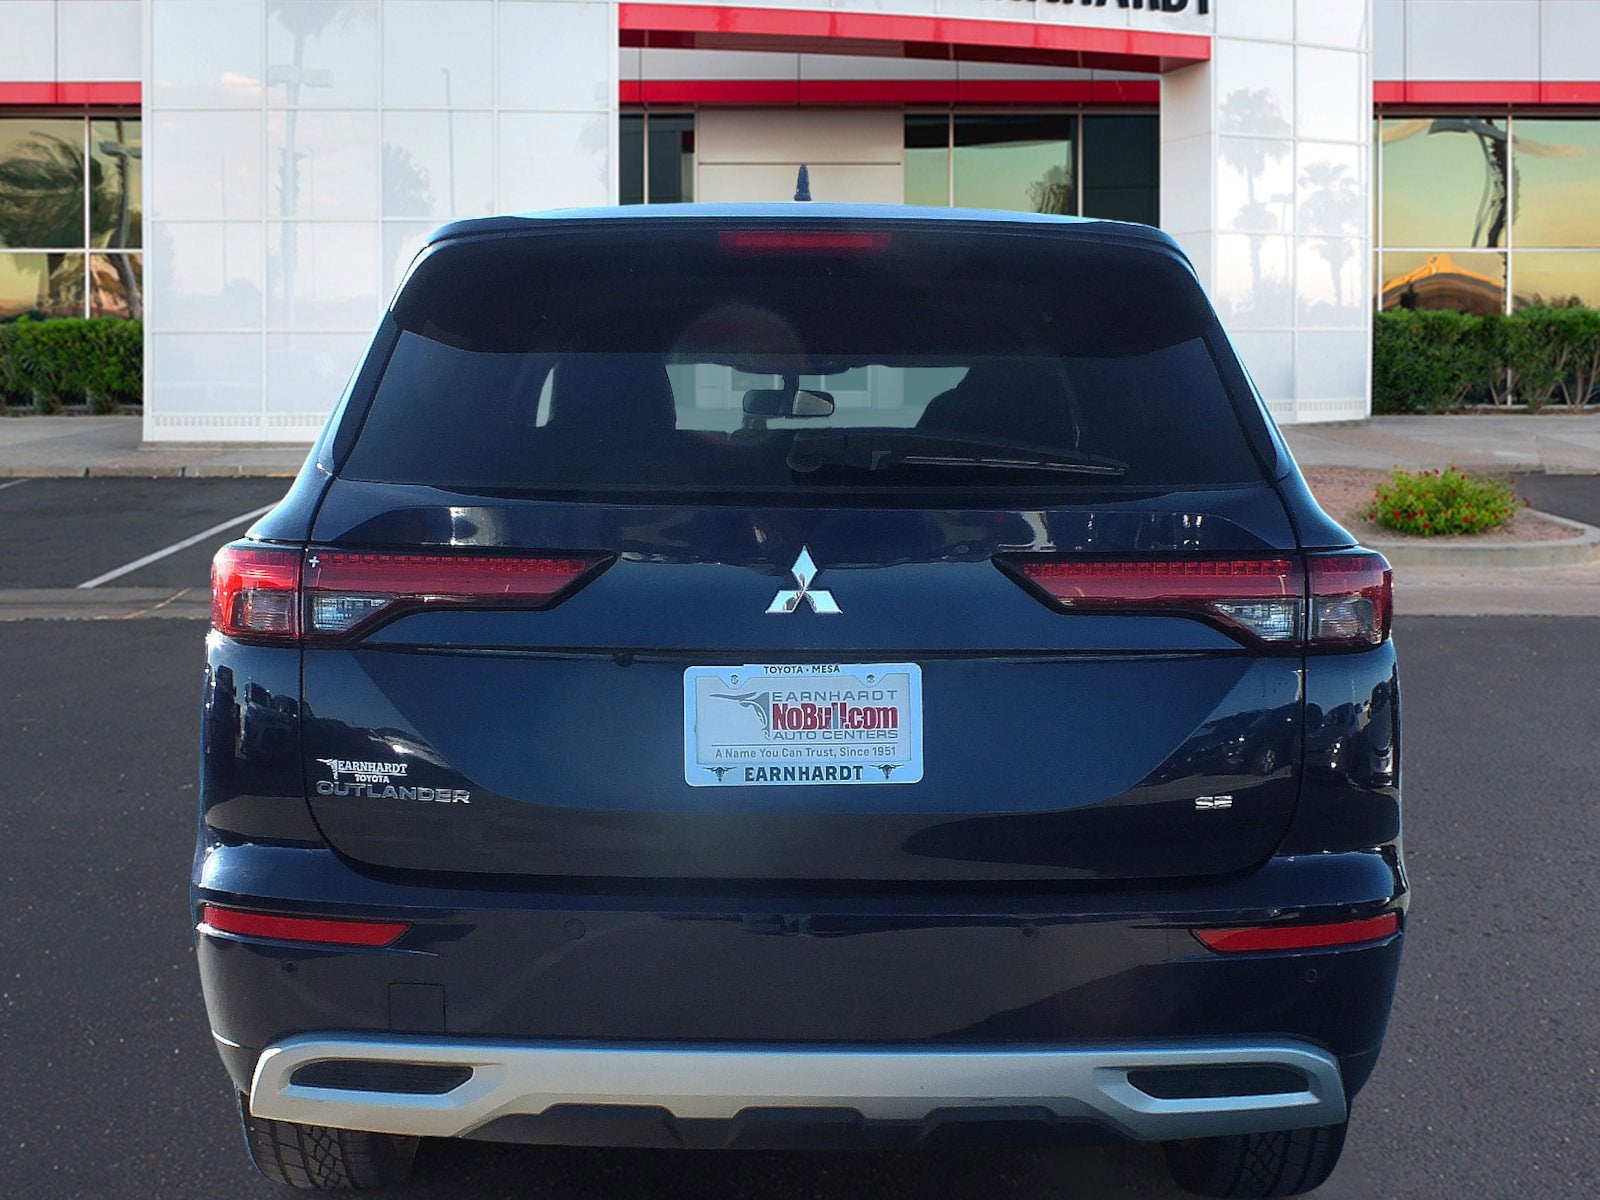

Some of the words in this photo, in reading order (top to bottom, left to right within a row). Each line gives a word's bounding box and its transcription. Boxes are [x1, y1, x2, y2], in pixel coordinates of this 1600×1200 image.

[763, 665, 804, 674] TOYOTA
[811, 664, 841, 674] MESA
[772, 690, 898, 702] EARNHARDT
[773, 730, 817, 740] AUTO
[822, 729, 899, 740] CENTERS
[715, 749, 723, 758] A
[725, 749, 757, 758] Name
[759, 749, 779, 758] You
[782, 748, 802, 758] Can
[804, 747, 837, 758] Trust,
[839, 746, 870, 757] Since
[872, 746, 896, 757] 1951
[338, 760, 408, 774] EARNHARDT
[355, 774, 390, 784] TOYOTA
[745, 765, 864, 782] EARNHARDT
[316, 780, 471, 804] OUTLANDER
